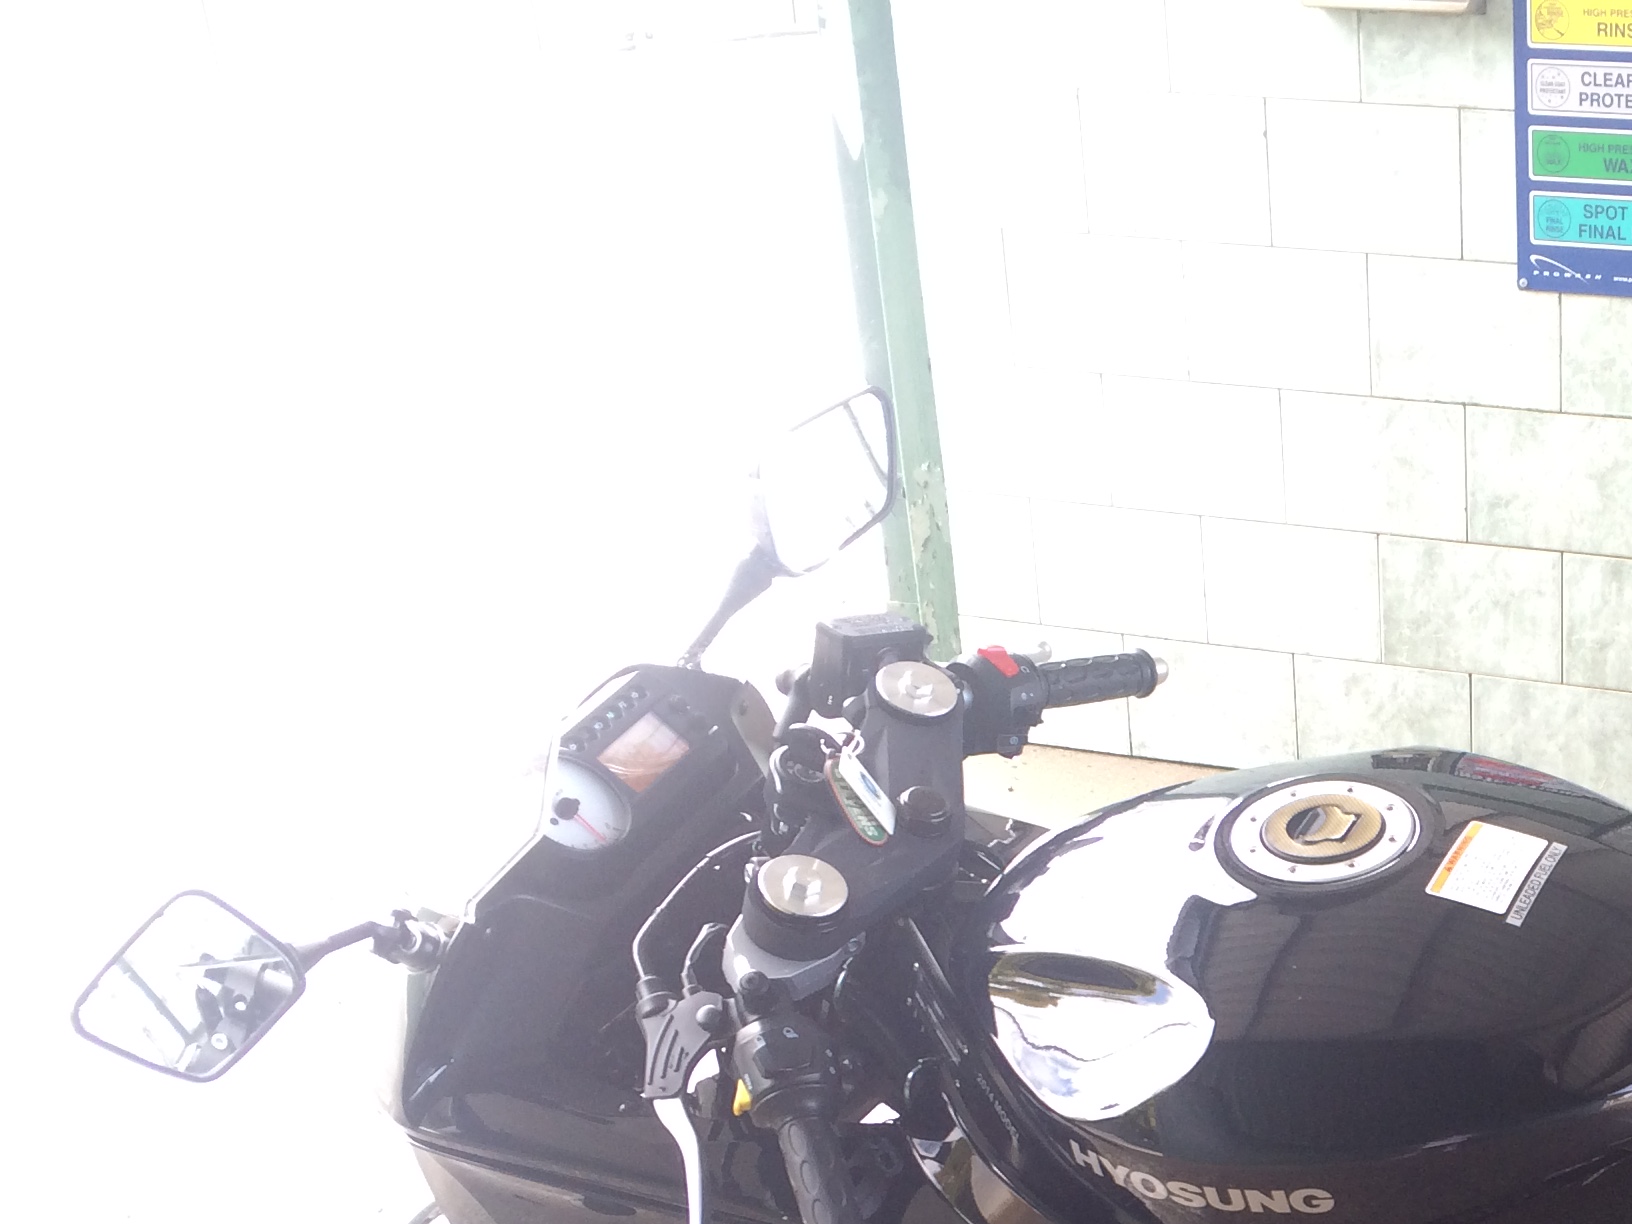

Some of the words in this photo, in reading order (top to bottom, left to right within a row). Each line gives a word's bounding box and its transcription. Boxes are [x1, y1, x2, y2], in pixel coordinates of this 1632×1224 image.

[1582, 8, 1607, 18] HIGH
[1578, 142, 1605, 154] HIGH
[1583, 203, 1628, 221] SPOT
[1578, 223, 1627, 241] FINAL
[1510, 879, 1542, 921] UNLEADED
[1533, 863, 1553, 880] FUEL
[1544, 845, 1563, 864] ONLY
[1069, 1138, 1336, 1215] HYOSUNG
